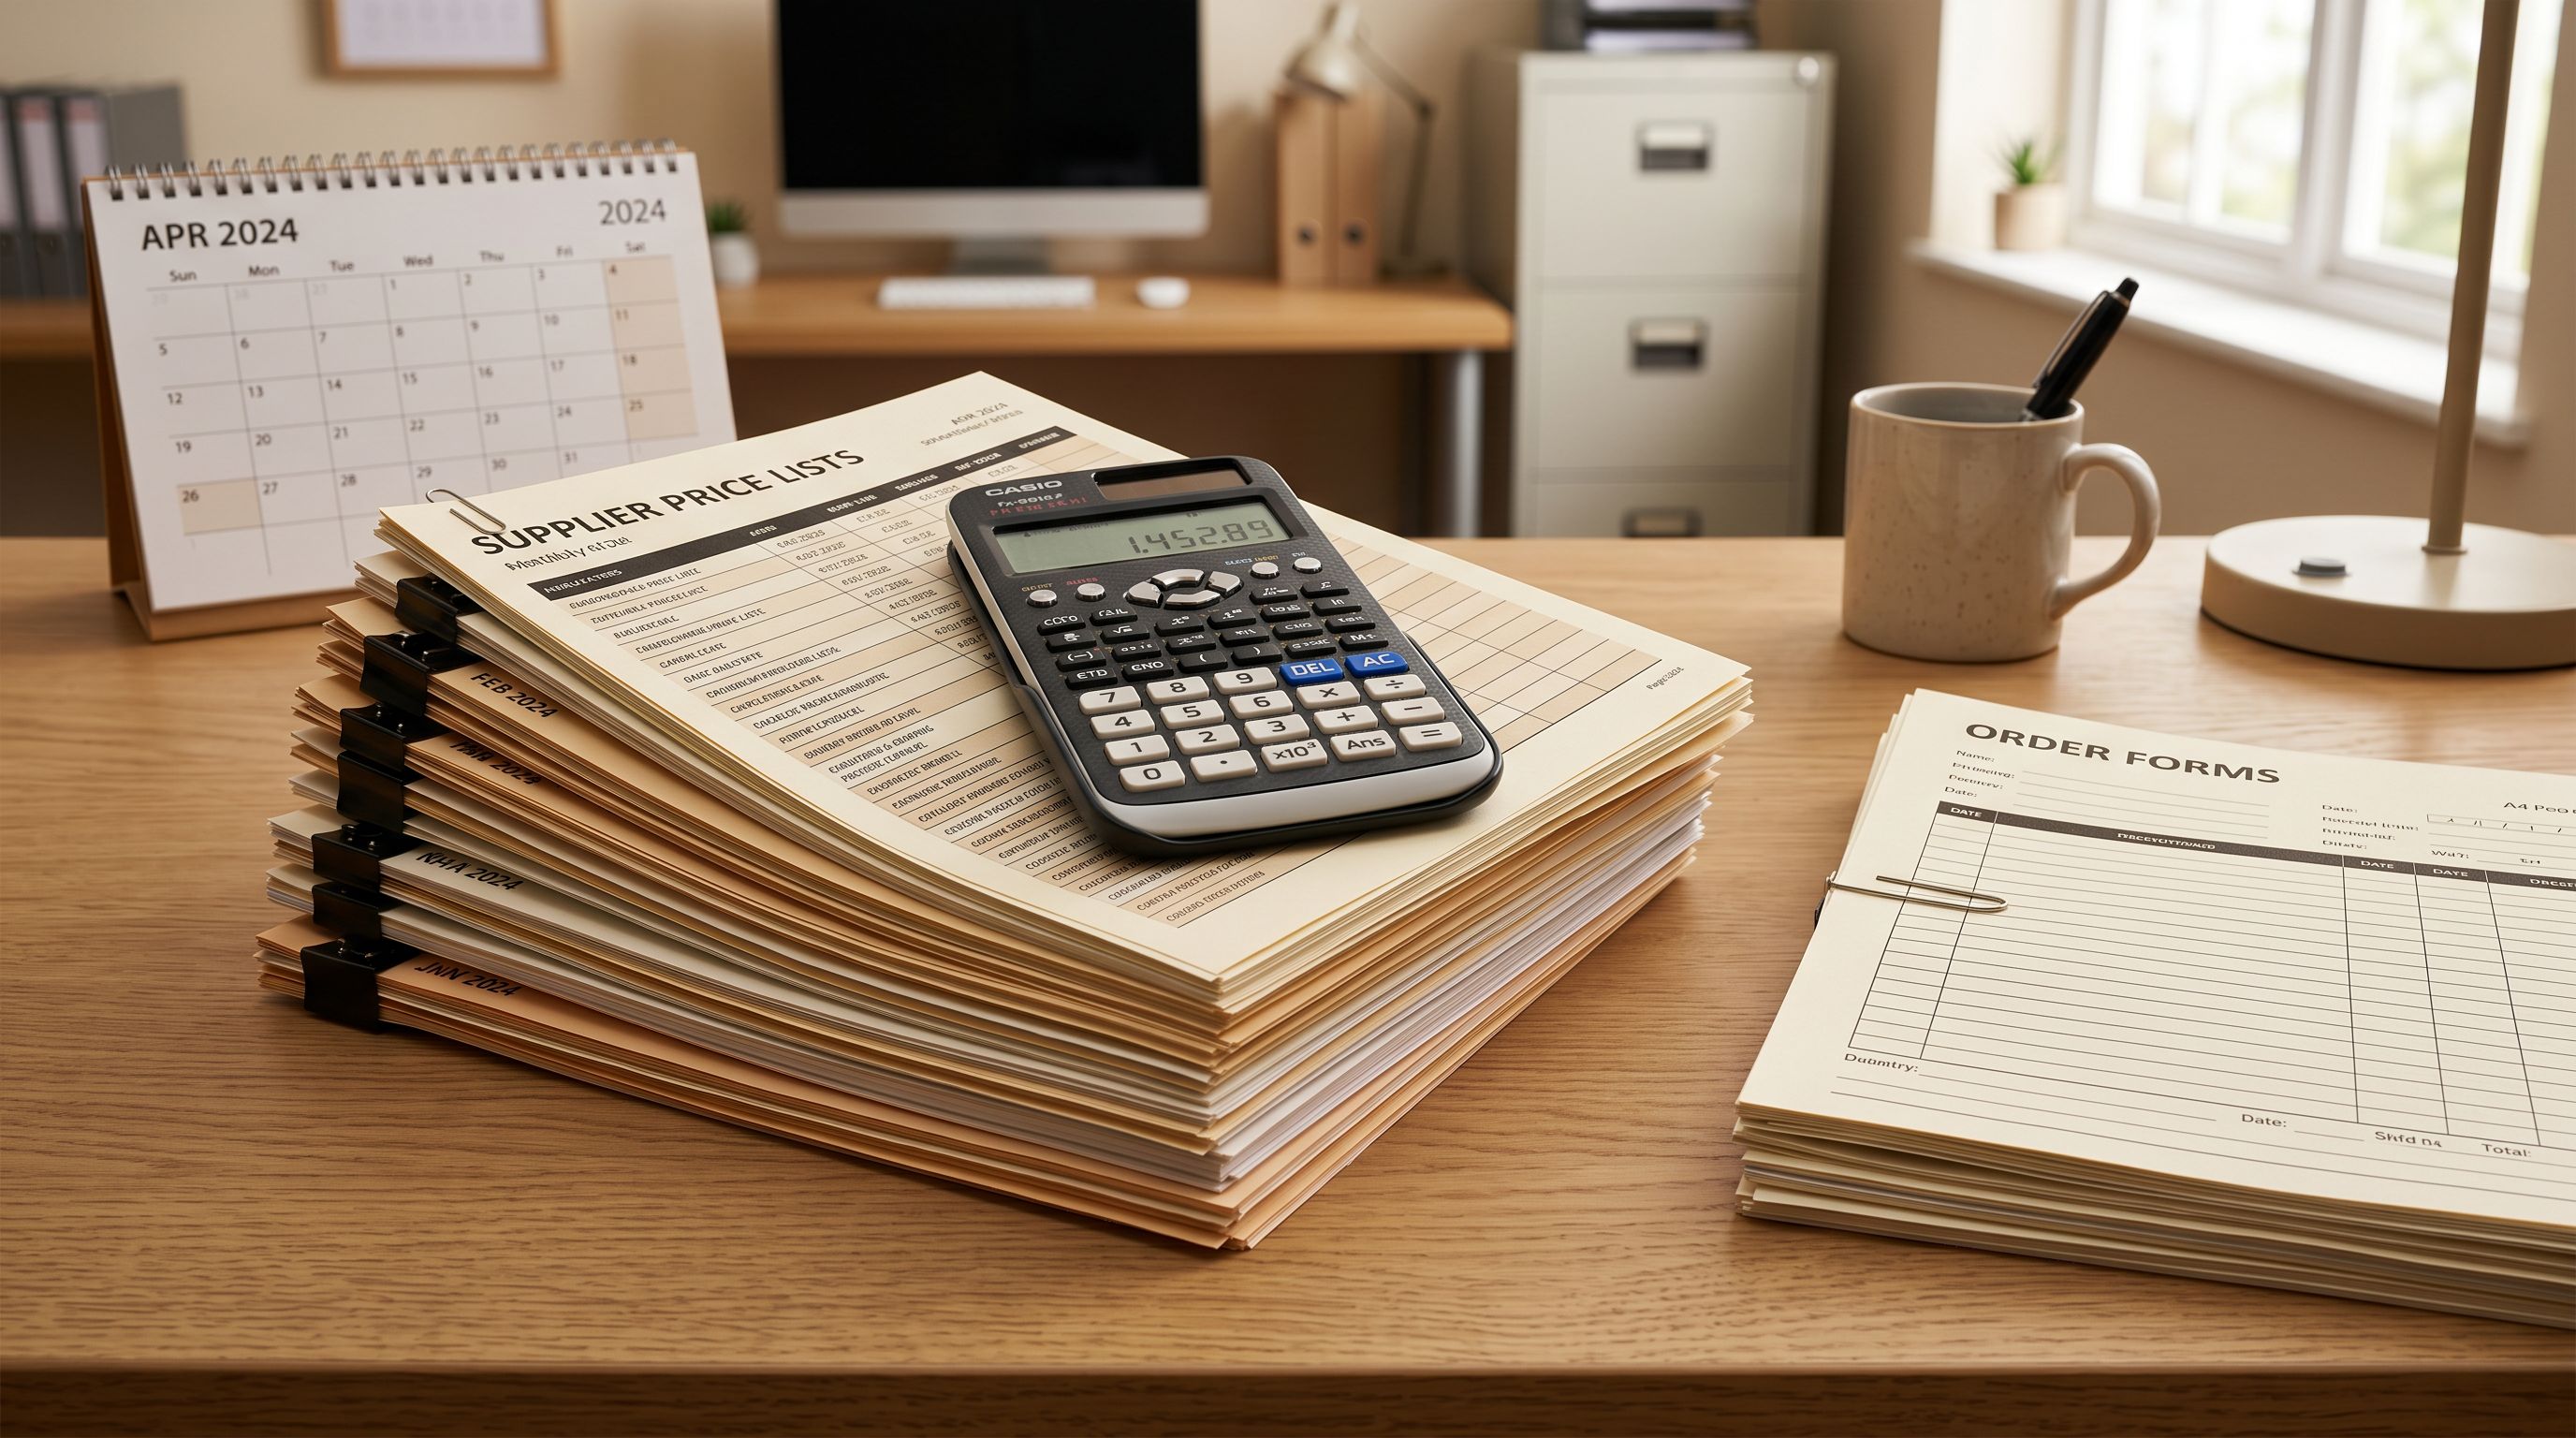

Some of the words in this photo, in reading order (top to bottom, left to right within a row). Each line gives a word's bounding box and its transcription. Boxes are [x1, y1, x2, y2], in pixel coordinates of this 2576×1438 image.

[599, 198, 666, 226] 2024
[141, 224, 209, 251] APR
[218, 218, 299, 246] 2024
[169, 270, 197, 282] Sun
[249, 266, 280, 277] Mon
[329, 260, 355, 272] Tue
[403, 256, 433, 267] Wed
[480, 250, 505, 262] Thu
[557, 246, 573, 257] Fri
[625, 242, 645, 254] Sat
[465, 273, 471, 286] 2
[538, 269, 545, 280] 3
[609, 264, 617, 275] 4
[159, 344, 168, 356] 5
[241, 338, 249, 350] 6
[319, 331, 327, 344] 7
[396, 326, 404, 337] 8
[471, 320, 478, 331] 9
[545, 315, 560, 326] 10
[616, 310, 629, 320] 11
[168, 392, 183, 405] 12
[248, 386, 264, 398] 13
[327, 379, 343, 391] 14
[402, 374, 417, 385] 15
[478, 366, 493, 377] 16
[550, 360, 564, 372] 17
[622, 355, 637, 366] 18
[175, 441, 191, 454] 19
[256, 433, 271, 447] 20
[334, 427, 348, 439] 21
[409, 419, 424, 432] 22
[484, 412, 499, 424] 23
[557, 405, 572, 418] 24
[629, 400, 643, 411] 25
[182, 491, 199, 504] 26
[262, 482, 278, 494] 27
[341, 474, 357, 487] 28
[417, 466, 432, 478] 29
[491, 459, 506, 470] 30
[564, 452, 578, 463] 31
[986, 480, 1063, 497] CASIO
[471, 501, 666, 555] SUPPLIER
[660, 474, 773, 512] PRICE
[768, 449, 866, 483] LISTS
[1128, 520, 1274, 554] 1.452.89
[1363, 653, 1395, 668] AC
[1290, 662, 1334, 676] DEL
[470, 672, 514, 694] FEB
[1237, 672, 1253, 684] 9
[1170, 681, 1187, 693] 8
[1099, 691, 1116, 703] 7
[1254, 696, 1270, 708] 6
[1183, 706, 1201, 718] 5
[1115, 715, 1132, 727] 4
[1267, 720, 1286, 732] 3
[1199, 730, 1217, 742] 2
[1347, 735, 1386, 750] Ans
[1131, 741, 1143, 753] 1
[1966, 724, 2111, 761] ORDER
[2126, 751, 2280, 784] FORMS
[1956, 750, 1996, 763] Name:
[1143, 767, 1161, 780] 0
[1944, 786, 1978, 798] Date:
[1951, 806, 1983, 818] DATE
[2503, 801, 2528, 811] A4
[2361, 859, 2394, 870] DATE
[2433, 867, 2469, 877] DATE
[464, 868, 524, 890] 2024
[461, 975, 521, 996] 2024
[2241, 1113, 2287, 1128] Date:
[2481, 1143, 2531, 1158] Total:
